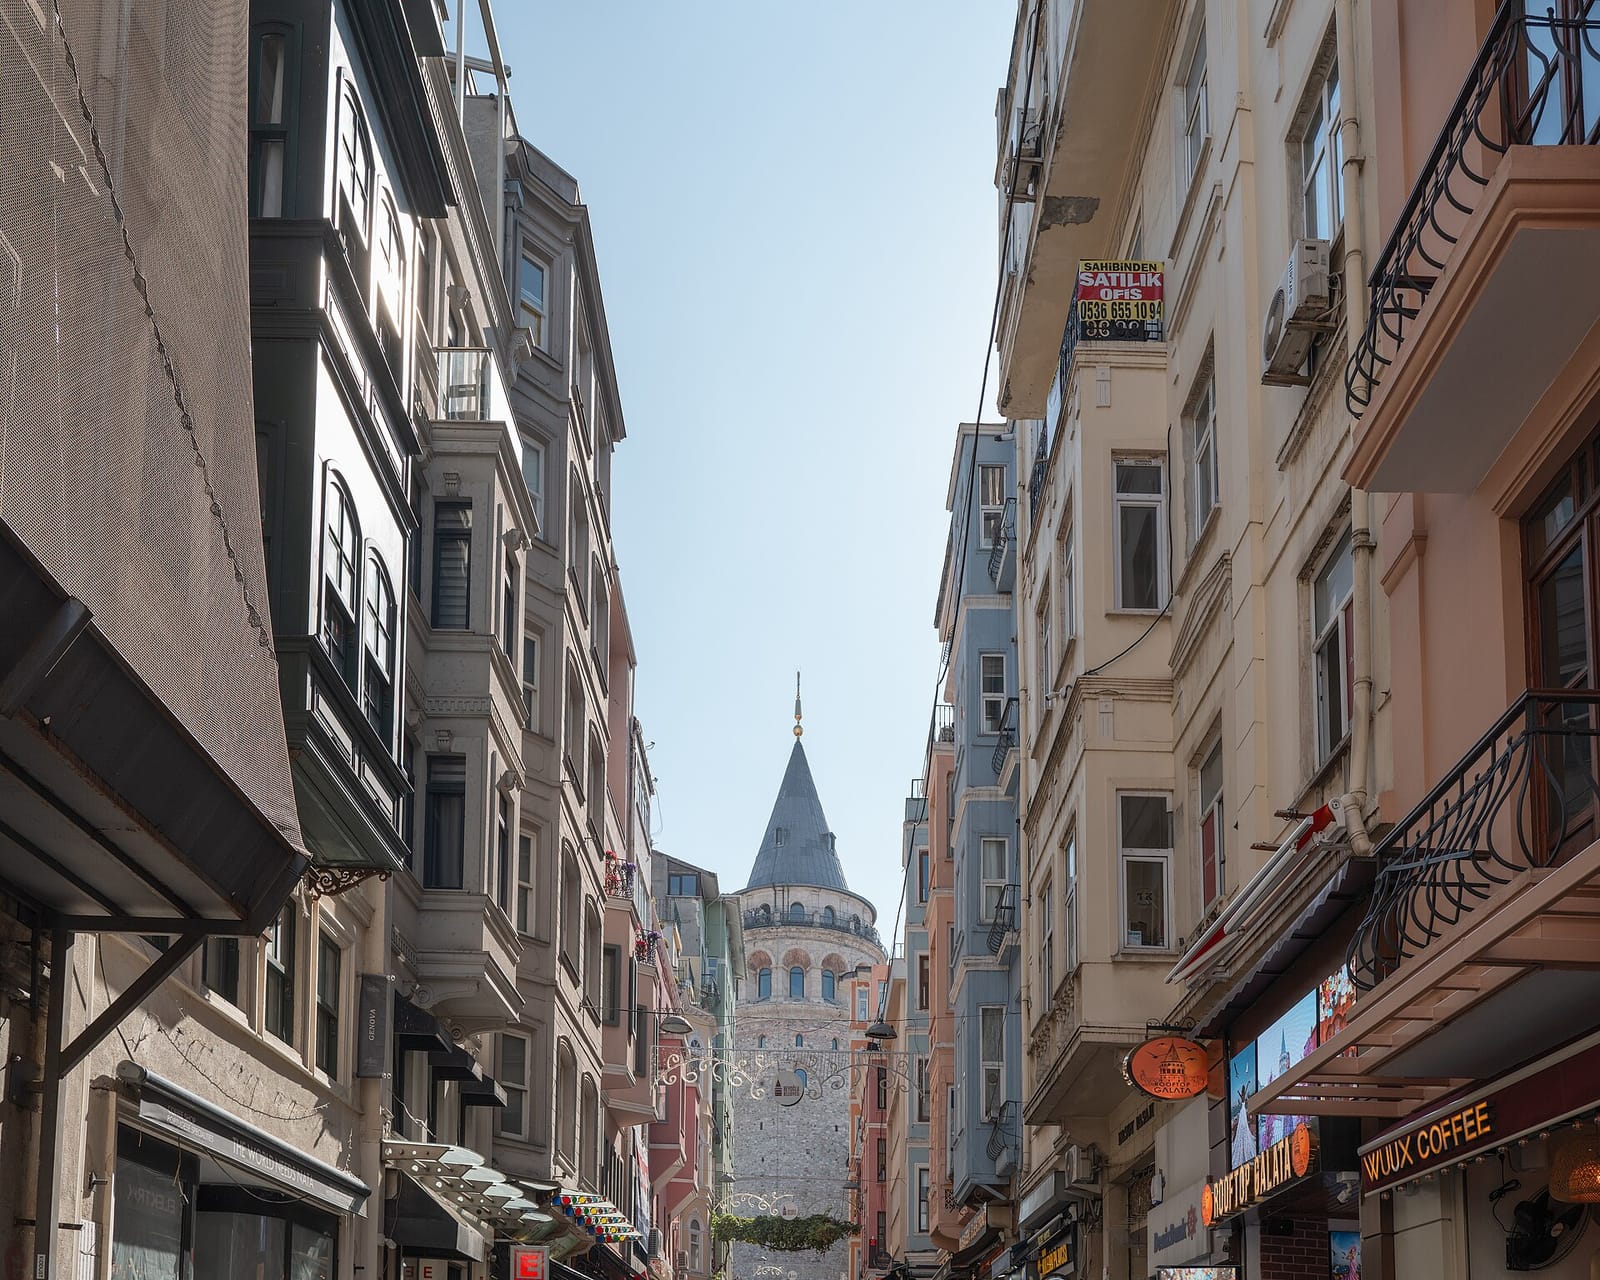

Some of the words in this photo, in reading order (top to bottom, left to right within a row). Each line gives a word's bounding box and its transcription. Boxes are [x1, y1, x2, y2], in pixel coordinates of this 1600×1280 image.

[1080, 272, 1162, 287] SATILIK
[1080, 301, 1107, 319] 0536
[1111, 301, 1132, 319] 655
[1134, 301, 1147, 319] 10
[1149, 301, 1161, 319] 94
[368, 1008, 377, 1041] GENOVA
[1153, 1086, 1192, 1094] GALATA
[1363, 1135, 1414, 1182] WUUX
[1417, 1101, 1491, 1160] COFFEE
[232, 1136, 246, 1160] THE
[247, 1143, 275, 1173] WORLD
[275, 1159, 297, 1181] NEEDS
[296, 1168, 314, 1188] NATA
[1213, 1162, 1250, 1219] ROOFTOP
[1253, 1136, 1292, 1196] GALATA
[521, 1255, 538, 1277] E
